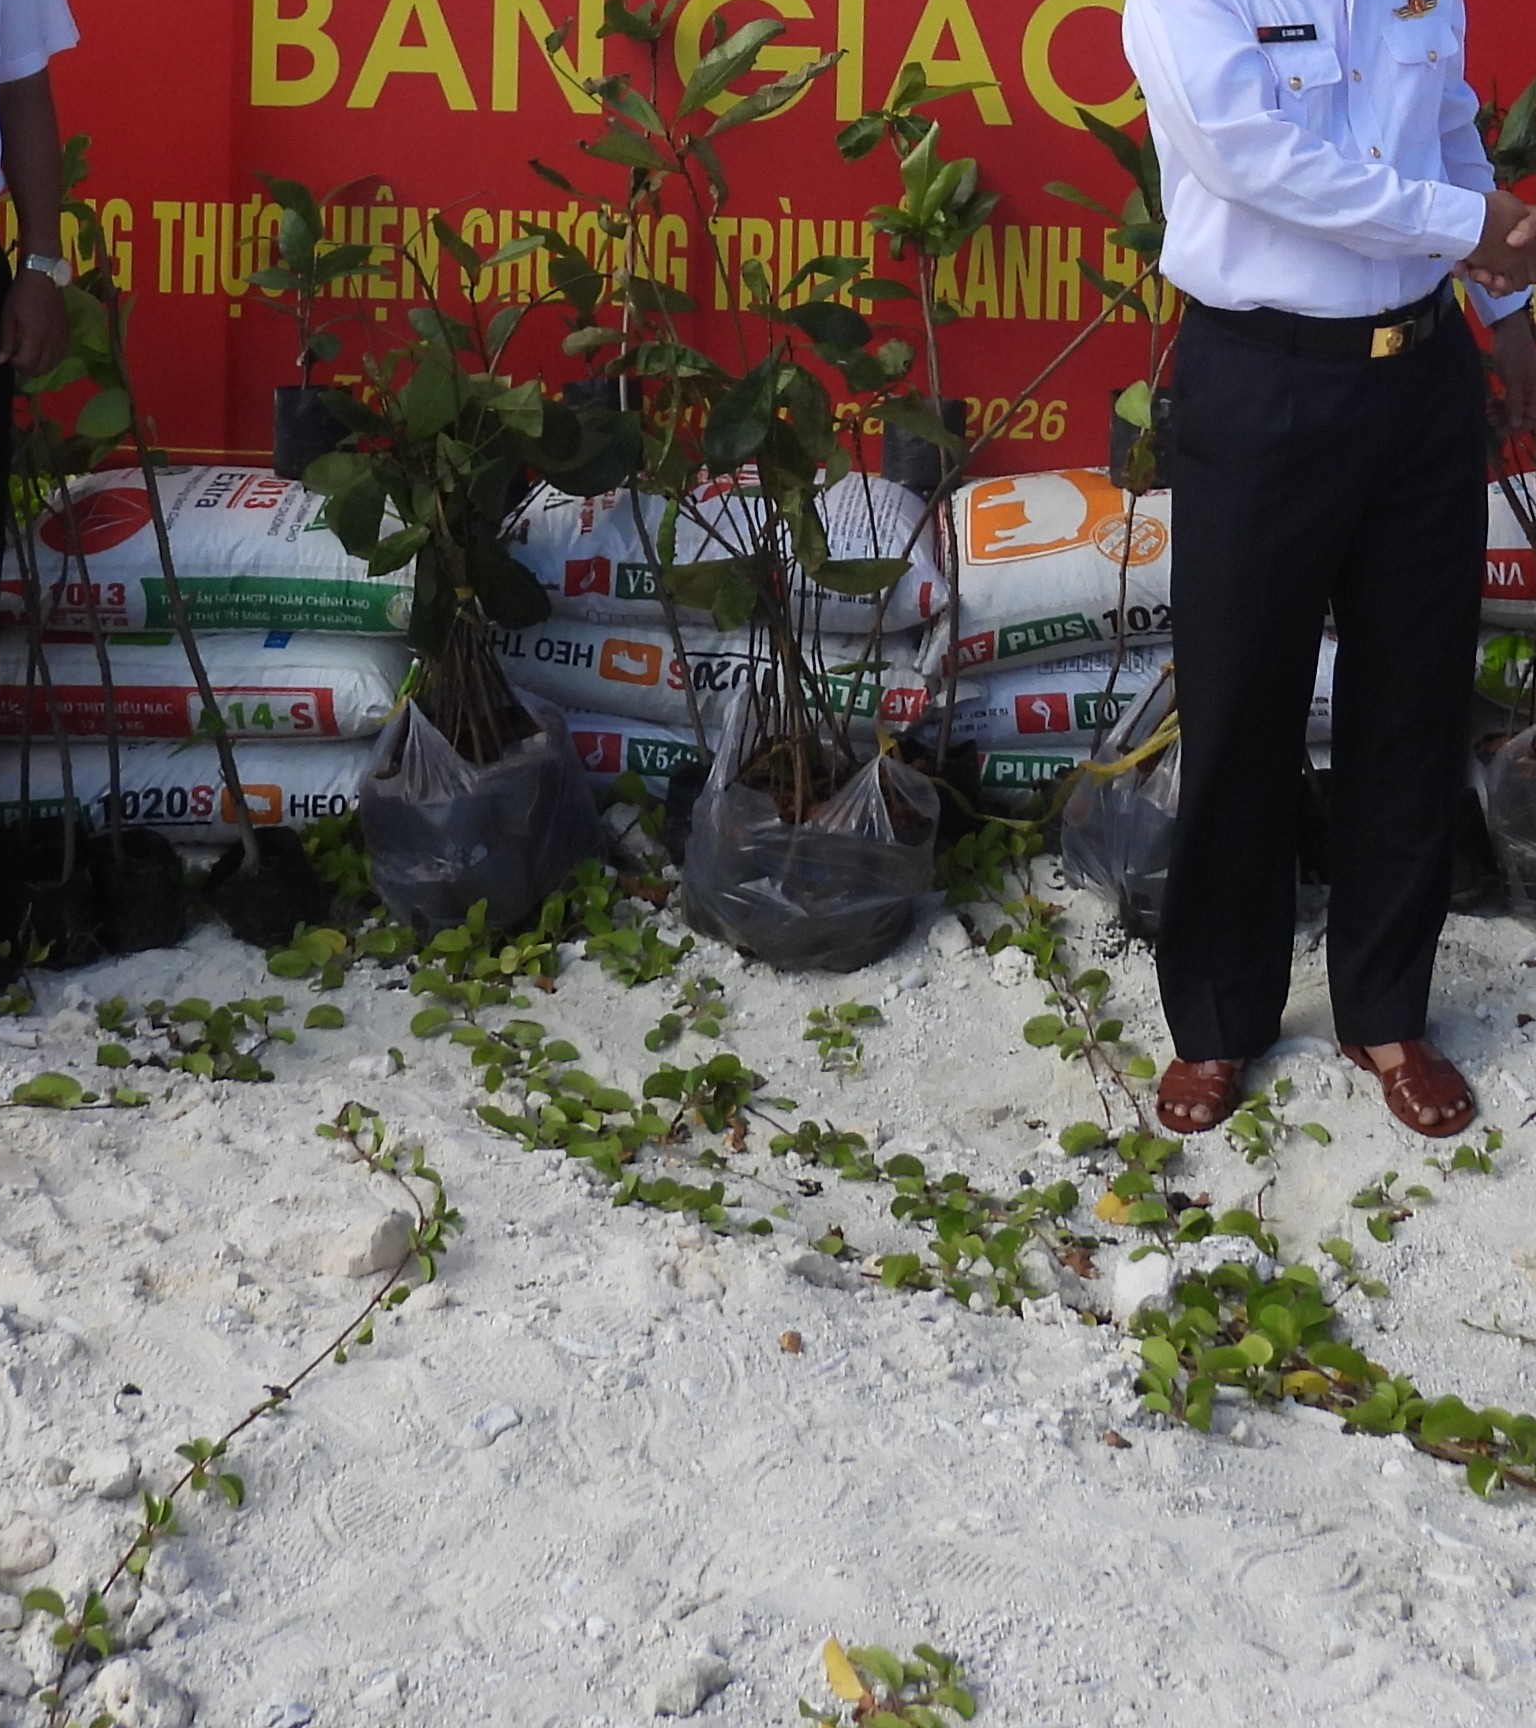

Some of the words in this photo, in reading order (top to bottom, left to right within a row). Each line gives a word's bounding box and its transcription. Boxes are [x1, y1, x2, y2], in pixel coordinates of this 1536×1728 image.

[316, 185, 440, 321] HIỆN
[709, 197, 876, 315] TRÌNH
[965, 397, 1067, 441] 2026
[195, 473, 245, 508] Extra
[244, 476, 291, 509] 013
[1007, 620, 1085, 651] PLUS
[535, 638, 594, 669] HEO
[290, 793, 347, 819] HEO
